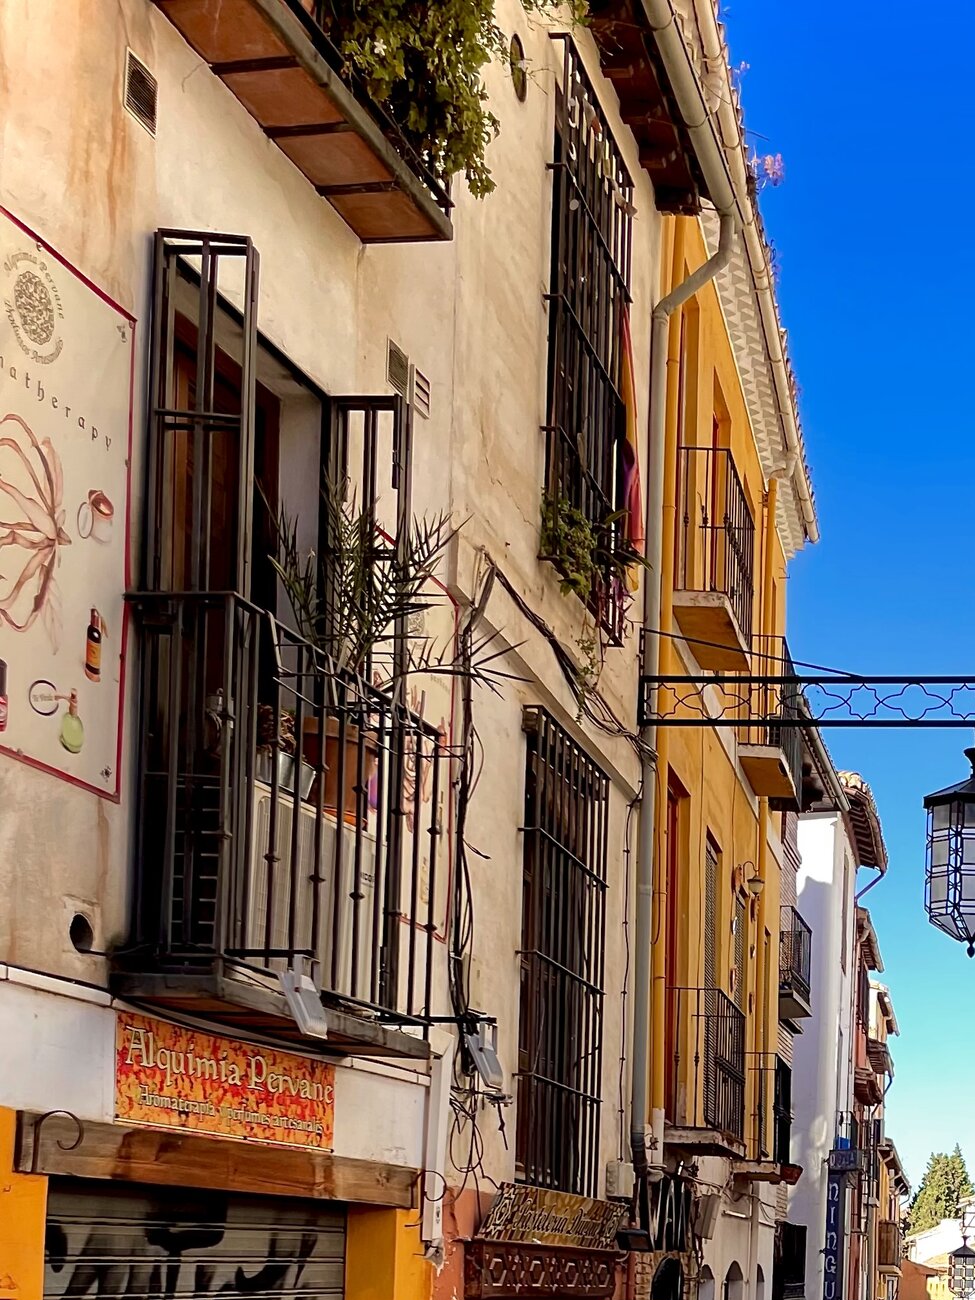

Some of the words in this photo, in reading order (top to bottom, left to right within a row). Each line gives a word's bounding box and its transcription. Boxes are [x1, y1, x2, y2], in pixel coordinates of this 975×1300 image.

[125, 1025, 241, 1087] Alquimia
[247, 1055, 334, 1104] Pervane
[272, 1115, 323, 1133] artesanales
